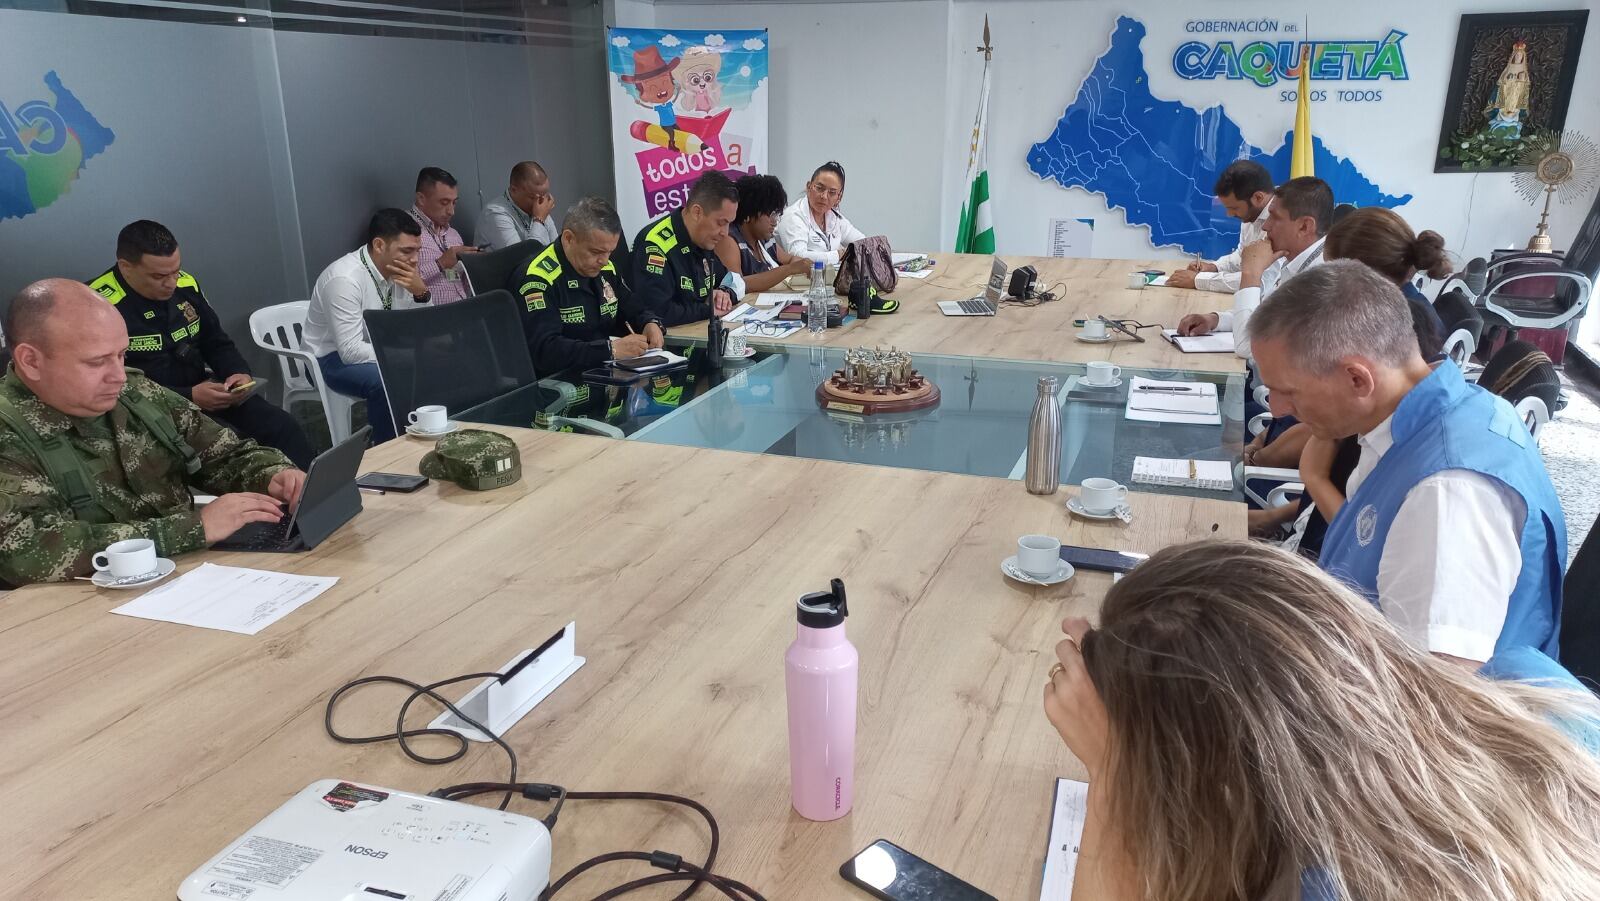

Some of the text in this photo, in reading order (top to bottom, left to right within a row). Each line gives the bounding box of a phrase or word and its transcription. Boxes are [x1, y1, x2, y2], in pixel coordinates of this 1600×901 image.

[1185, 19, 1299, 33] GOBERNACIÓN DEL
[1172, 28, 1409, 87] CAQUETÁ
[1280, 90, 1382, 102] SOOS TODOS
[646, 143, 742, 183] todos a
[344, 843, 389, 860] EPSON
